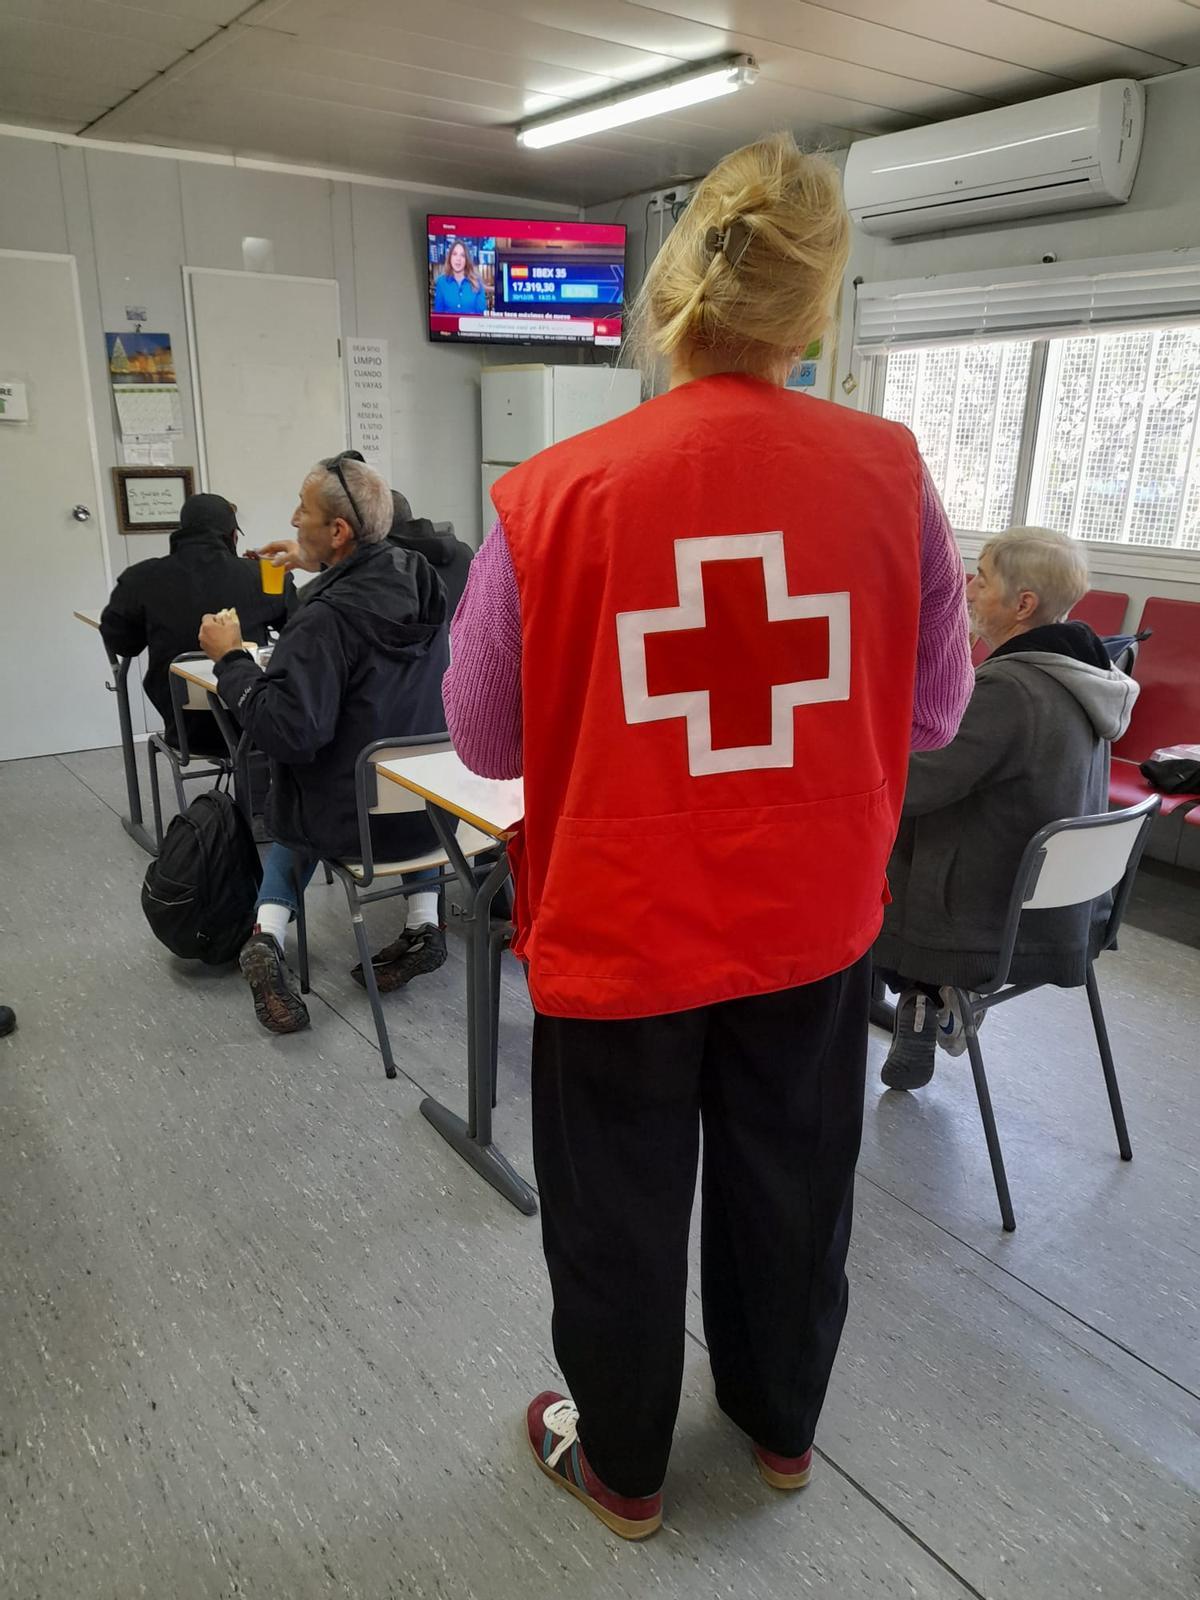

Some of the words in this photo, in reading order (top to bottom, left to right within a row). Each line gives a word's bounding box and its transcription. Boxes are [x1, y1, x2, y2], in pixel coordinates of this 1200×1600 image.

[532, 267, 554, 278] IBEX
[555, 268, 567, 278] 35
[353, 356, 382, 366] LIMPIO
[354, 369, 382, 378] CUANDO
[361, 382, 383, 390] VAYAS
[362, 433, 371, 441] EN
[371, 433, 379, 441] LA
